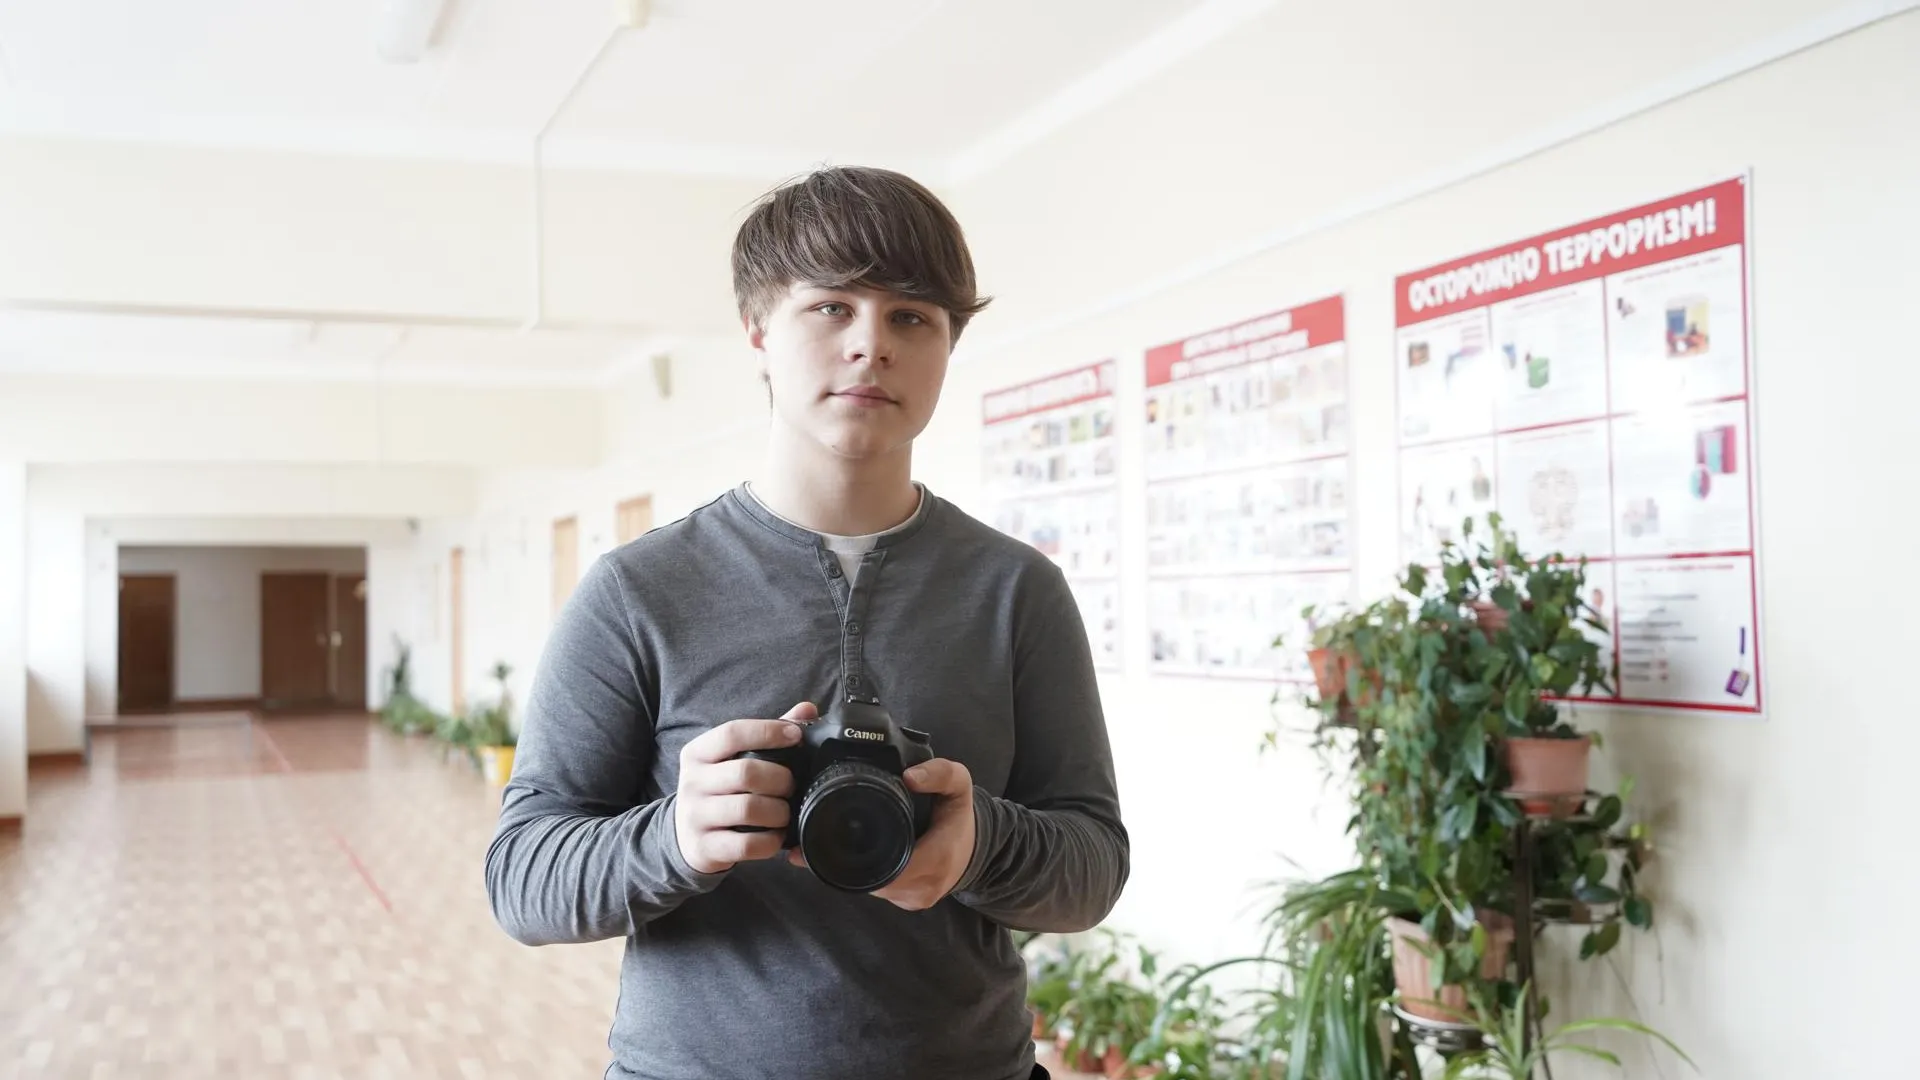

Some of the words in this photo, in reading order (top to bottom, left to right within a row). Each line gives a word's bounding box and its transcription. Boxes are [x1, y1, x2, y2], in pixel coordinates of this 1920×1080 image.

[1408, 247, 1541, 312] ОСТОРОЖНО
[1543, 198, 1717, 275] ТЕРРОРИЗМ!
[844, 728, 884, 741] Canon
